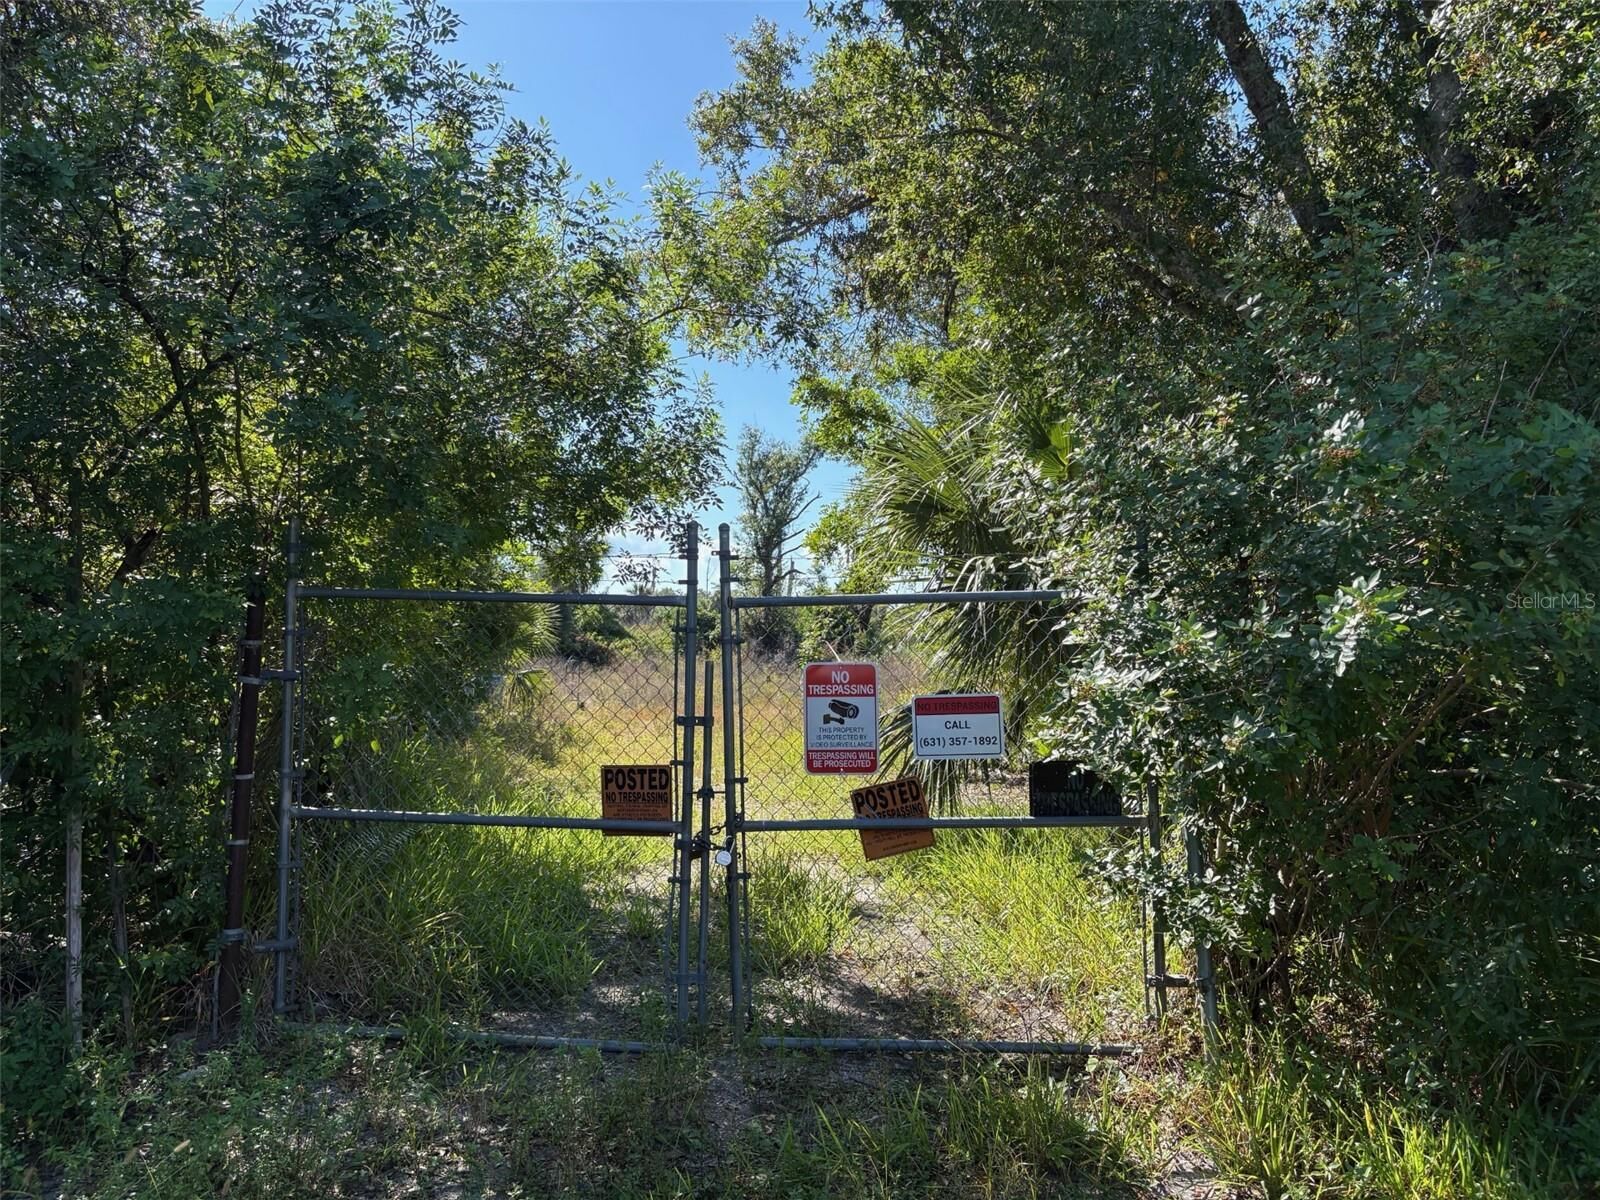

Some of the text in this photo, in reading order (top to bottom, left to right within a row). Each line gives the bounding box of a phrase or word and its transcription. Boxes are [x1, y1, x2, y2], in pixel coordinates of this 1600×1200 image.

[831, 670, 850, 684] NO
[807, 684, 874, 695] TRESPASSING
[917, 701, 997, 712] NO TRESPASSING
[944, 720, 971, 730] CALL
[919, 736, 998, 748] (631) 357-1892
[808, 751, 876, 760] TRESPASSING WILL
[813, 760, 871, 768] BE PROSECUTED
[604, 768, 669, 790] POSTED
[605, 791, 668, 803] NO TRESPASSING
[853, 780, 920, 814] POSTED
